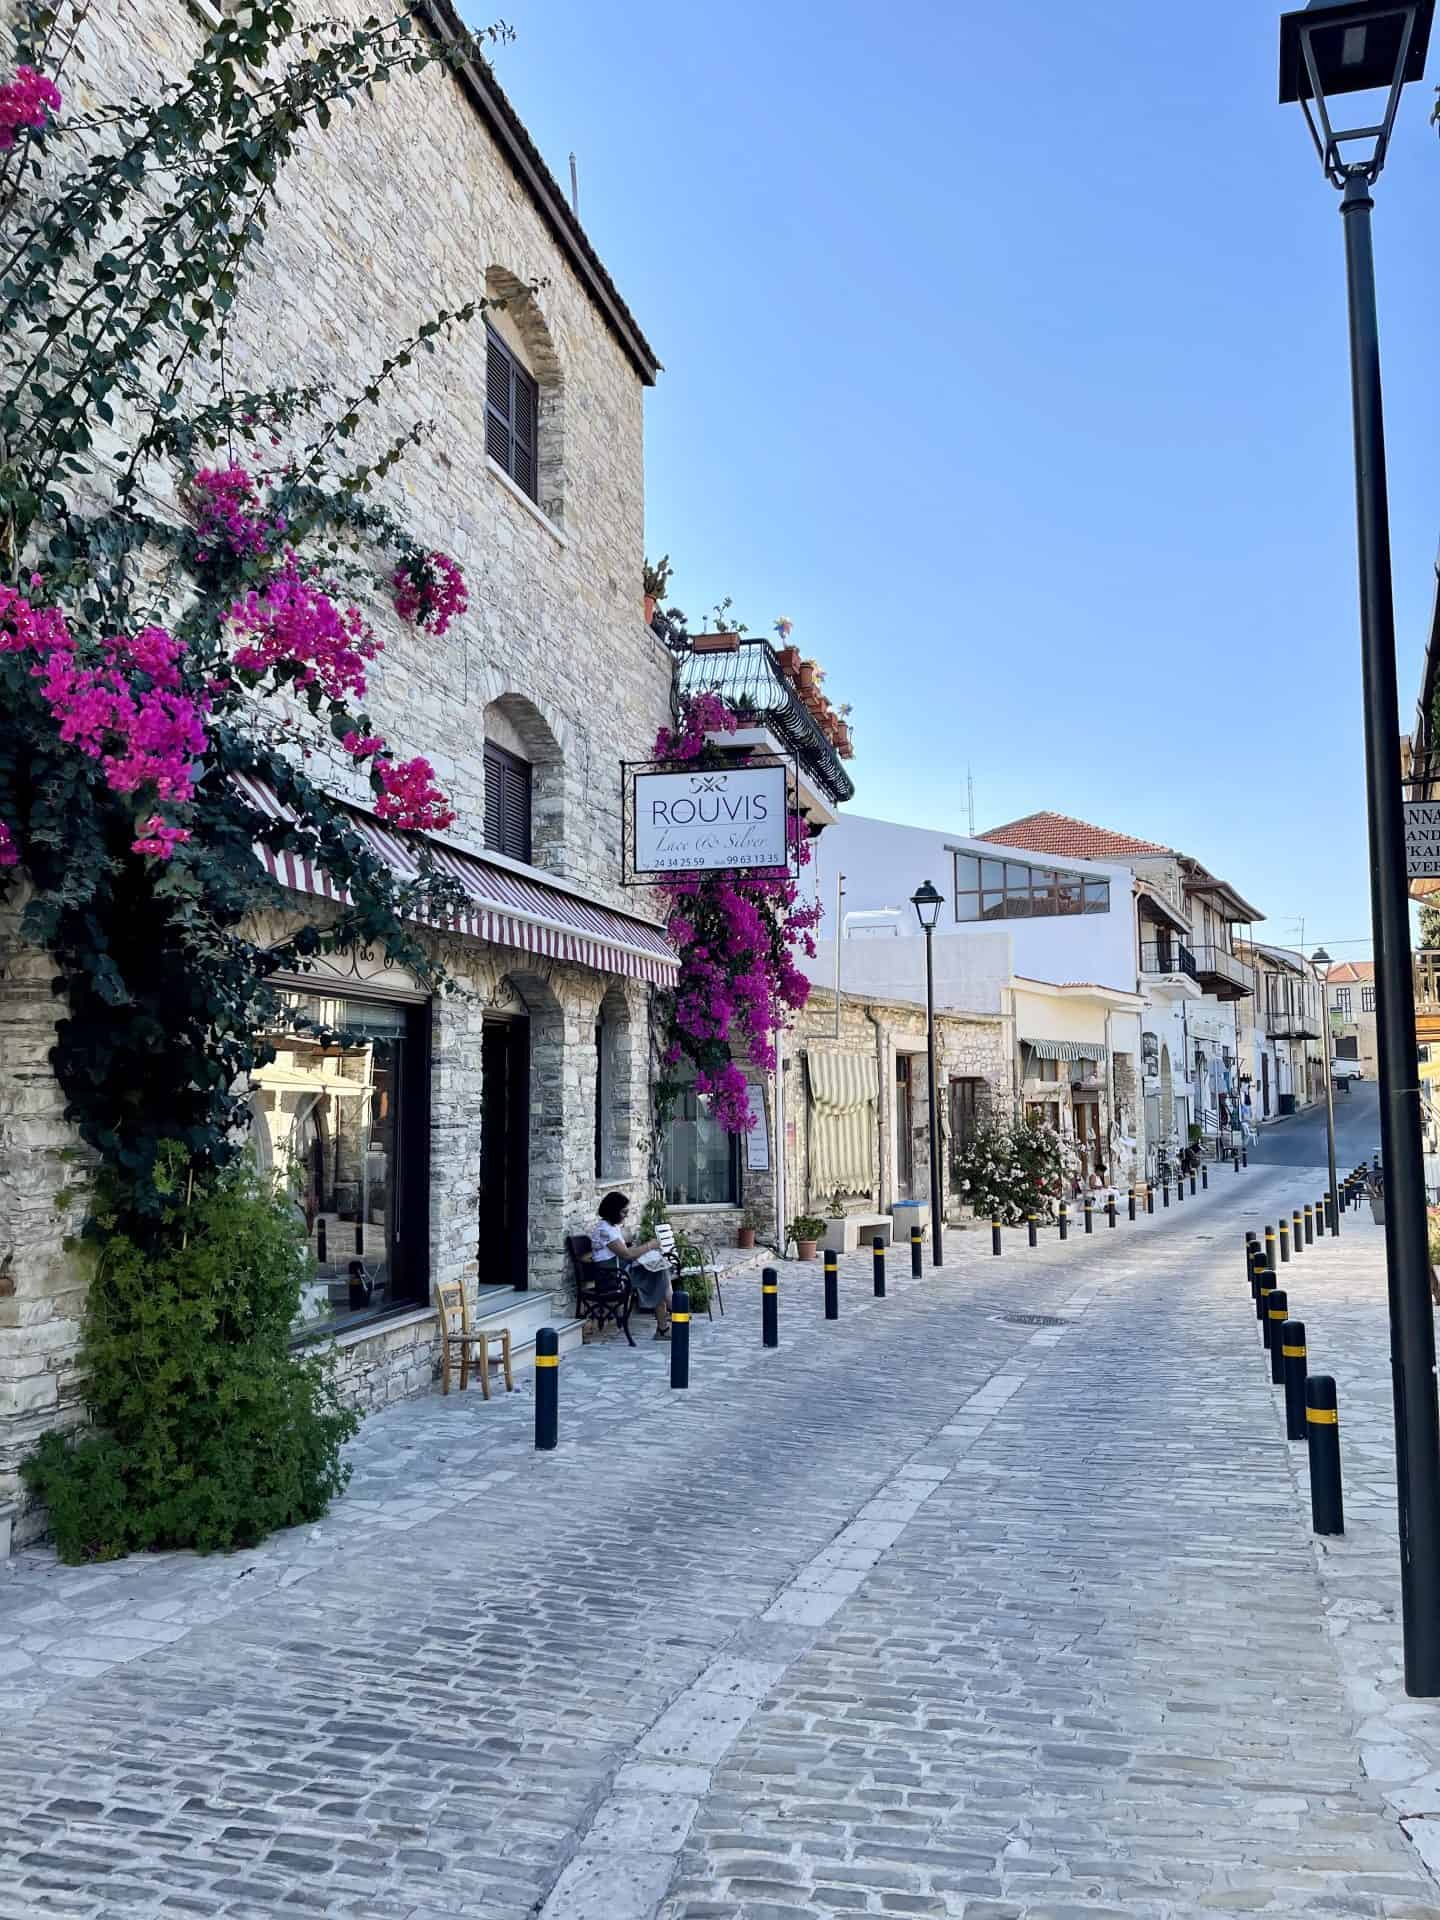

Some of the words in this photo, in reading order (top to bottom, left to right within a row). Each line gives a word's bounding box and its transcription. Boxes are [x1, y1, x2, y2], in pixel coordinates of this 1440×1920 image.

[653, 795, 767, 825] ROUVIS
[724, 825, 767, 848] Silver
[1407, 845, 1440, 857] KA
